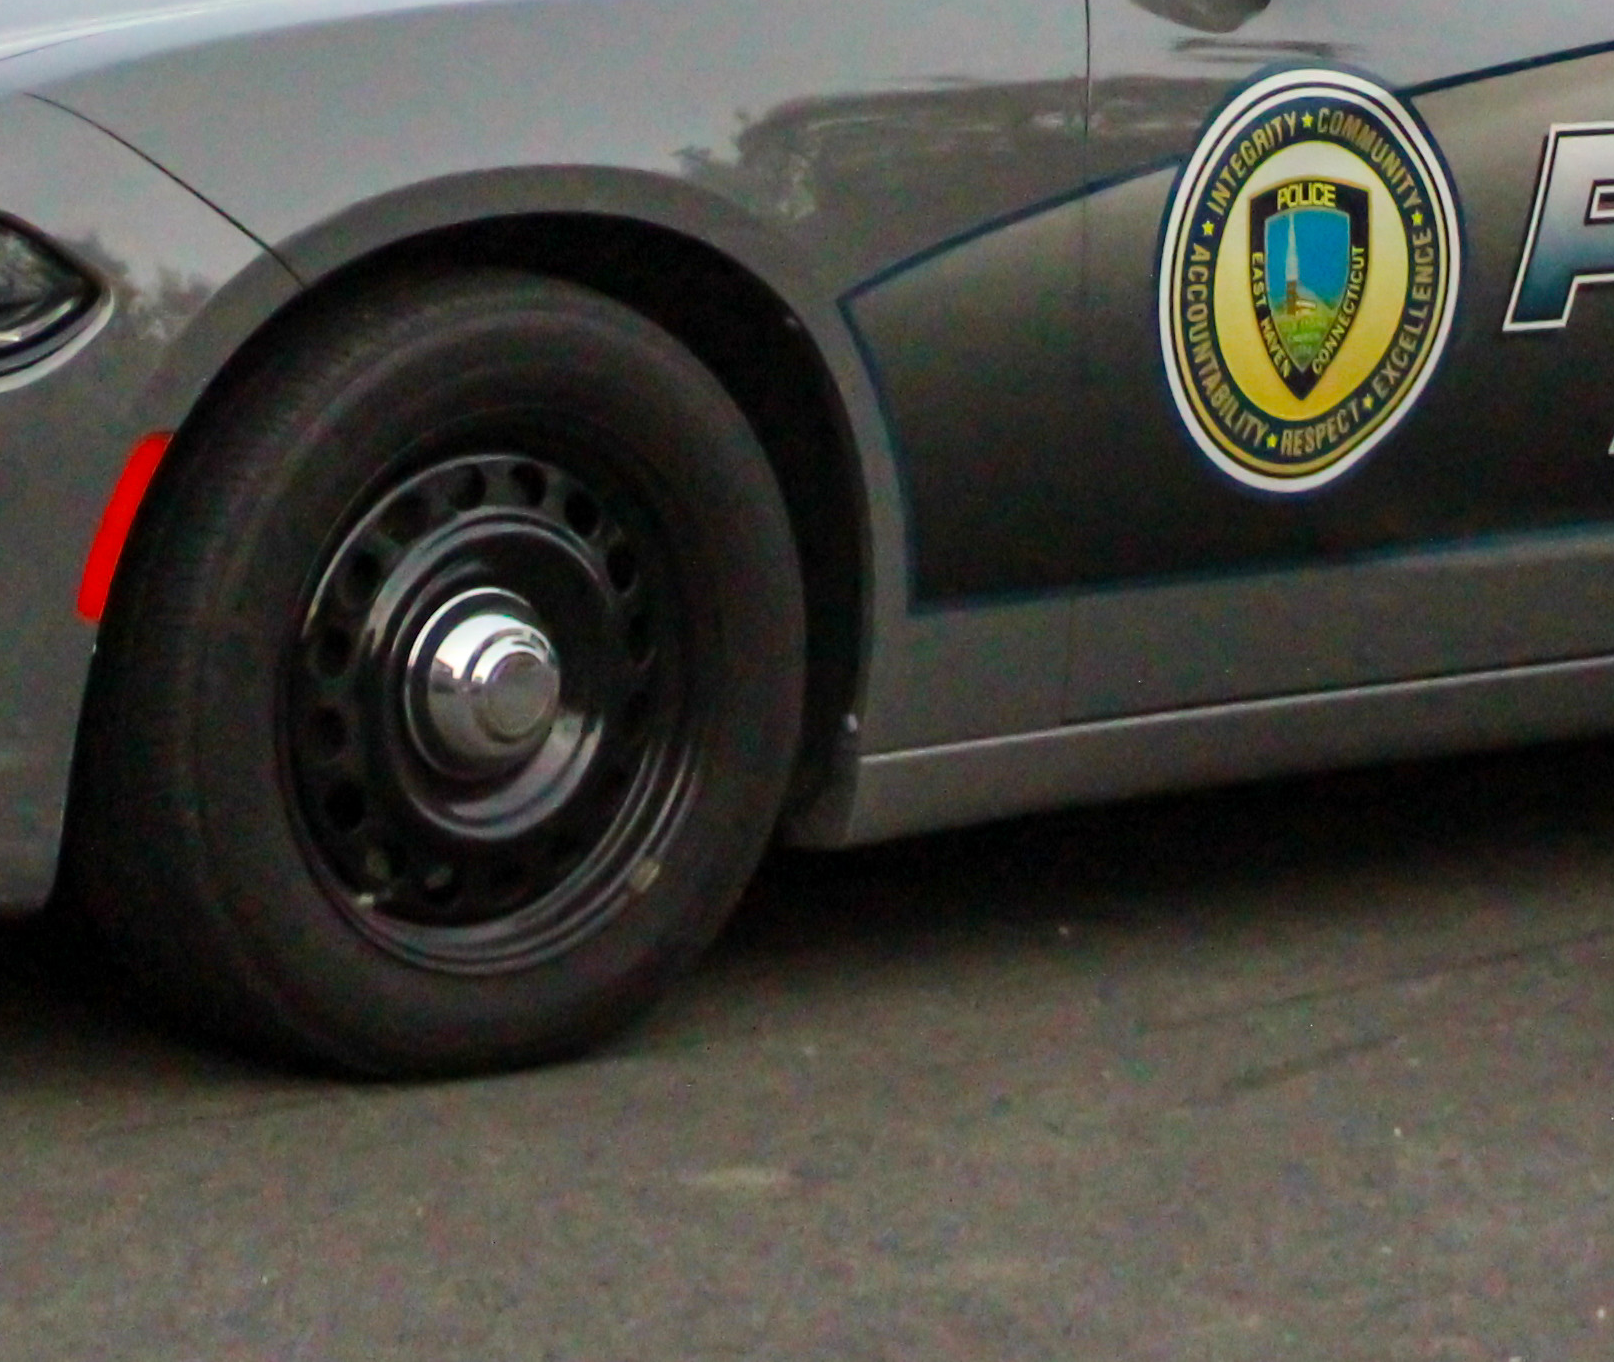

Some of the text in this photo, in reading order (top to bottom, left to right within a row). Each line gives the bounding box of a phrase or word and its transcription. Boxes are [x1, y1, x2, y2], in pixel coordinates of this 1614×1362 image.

[1206, 110, 1297, 216] INTEGRITY
[1277, 182, 1337, 210] POLICE
[1317, 107, 1424, 209] COMMUNITY
[1251, 252, 1268, 307] EAST
[1312, 245, 1366, 376] CONNECTICUT
[1372, 227, 1435, 400] EXCELLENCE
[1187, 243, 1269, 448] ACCOUNTABILITY
[1281, 400, 1361, 458] RESPECT
